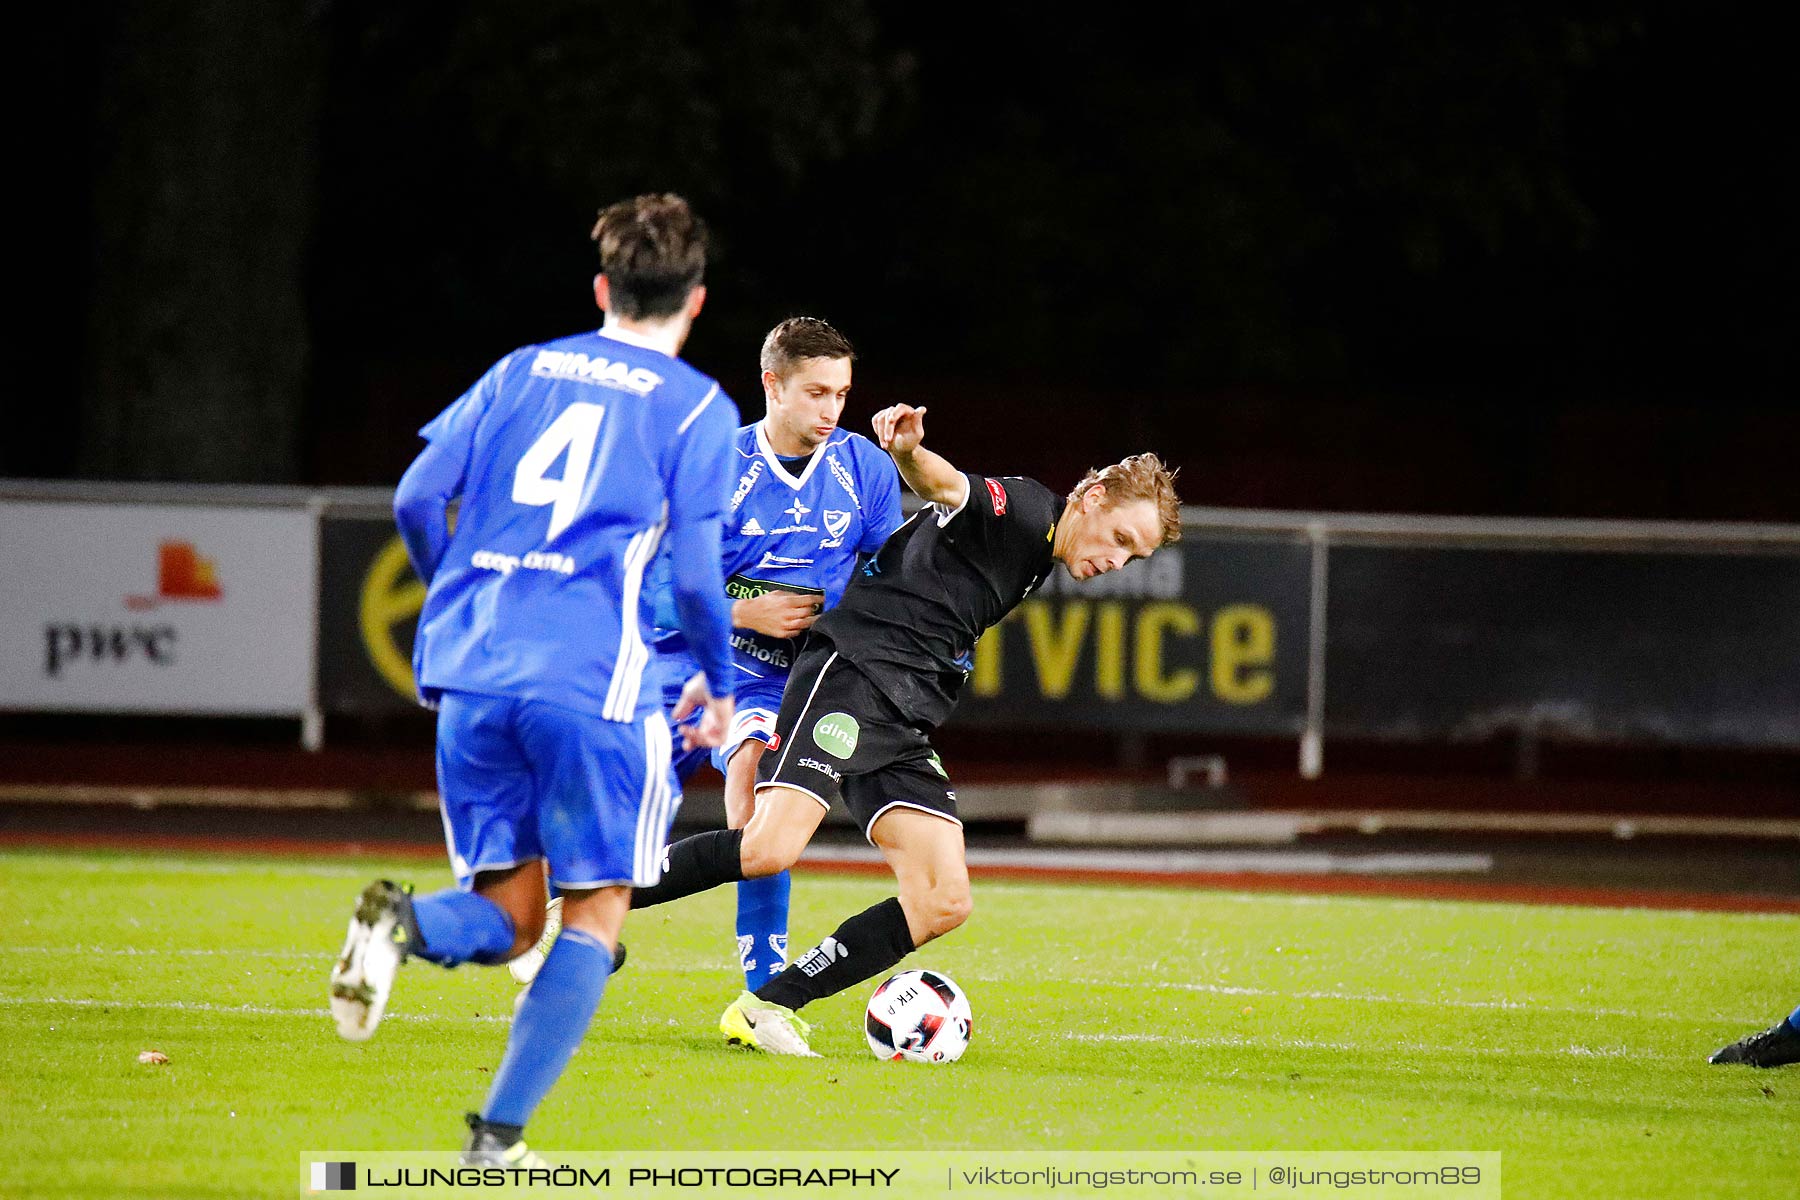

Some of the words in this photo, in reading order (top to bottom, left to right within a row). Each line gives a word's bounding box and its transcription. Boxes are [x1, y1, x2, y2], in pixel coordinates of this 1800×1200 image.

[512, 402, 605, 542] 4
[45, 622, 177, 677] pwc
[819, 722, 857, 750] dina
[801, 953, 831, 978] INTER
